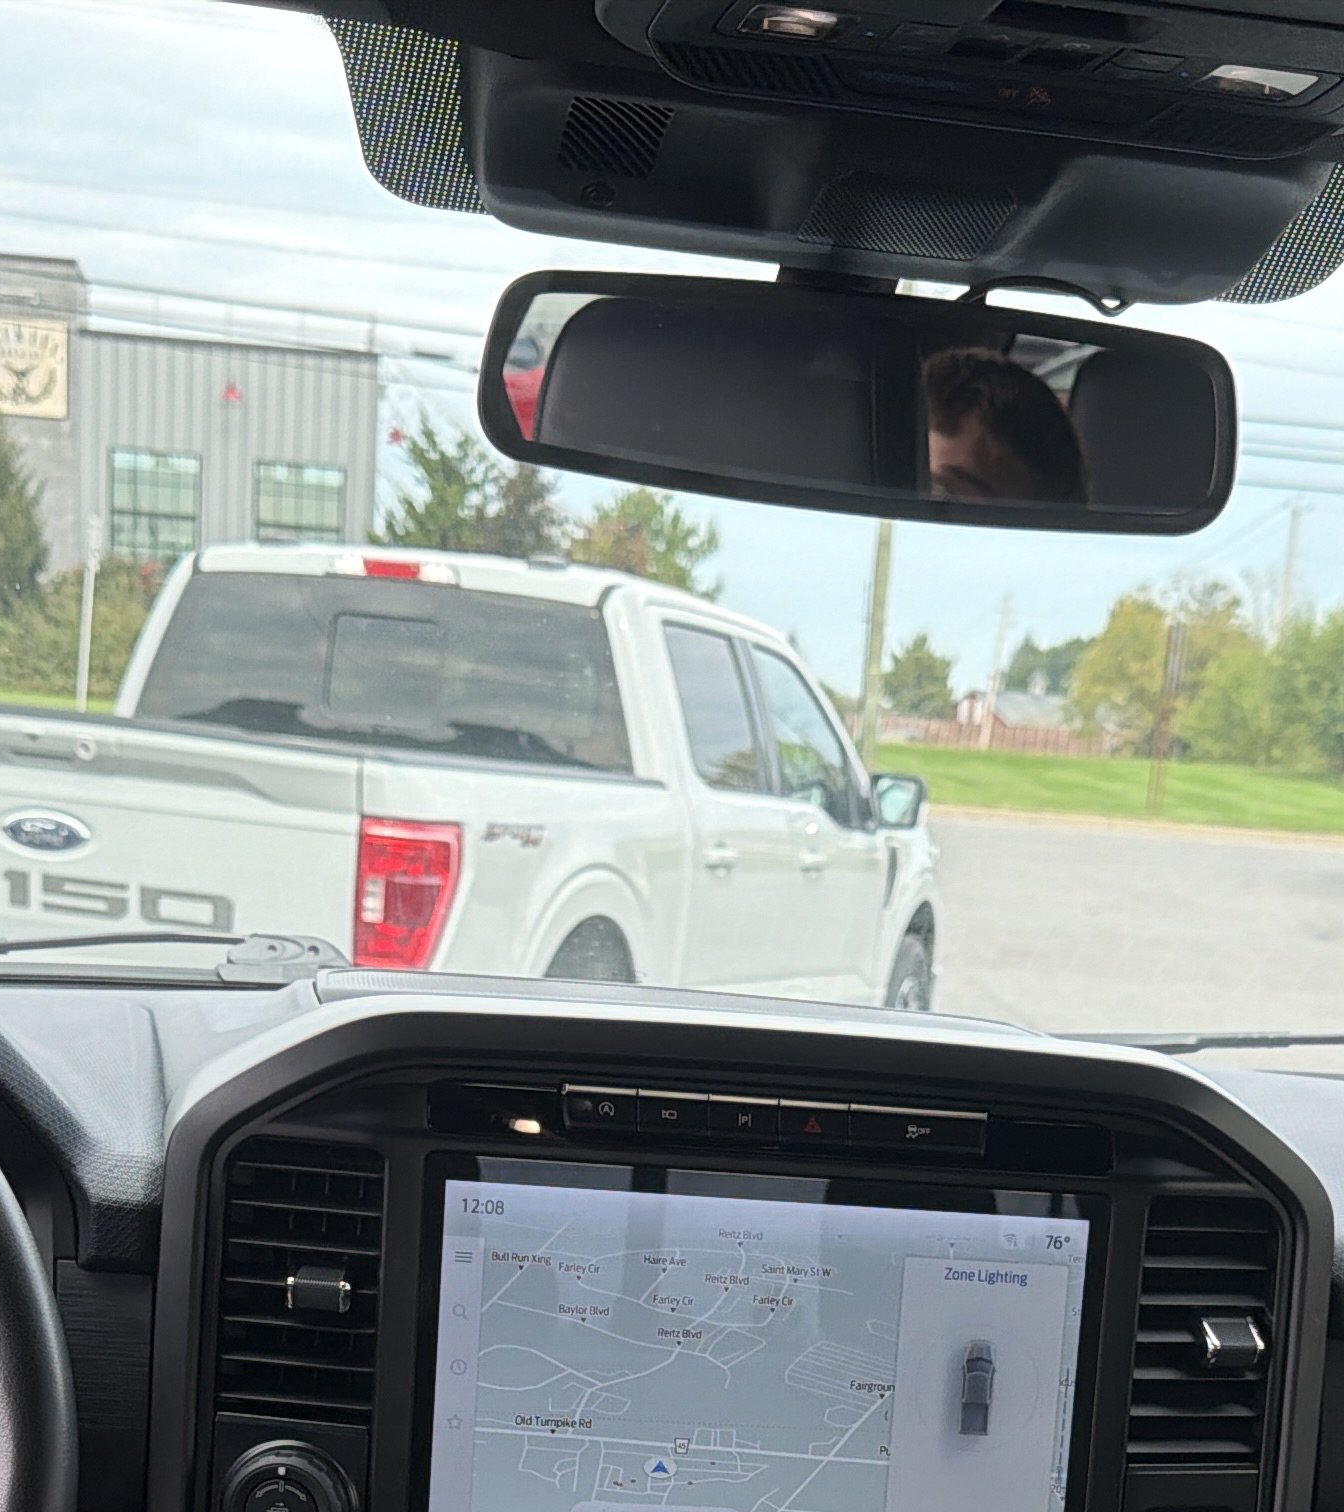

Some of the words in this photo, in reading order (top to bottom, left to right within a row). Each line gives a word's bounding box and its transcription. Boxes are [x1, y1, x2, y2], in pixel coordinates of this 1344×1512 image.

[462, 1198, 505, 1215] 12:08
[718, 1229, 741, 1240] Reitz
[742, 1230, 763, 1241] Blvd
[1045, 1234, 1071, 1250] 76°
[491, 1251, 509, 1263] Bull
[511, 1252, 530, 1263] Run
[531, 1254, 552, 1266] Xing
[668, 1257, 687, 1267] Ave
[558, 1262, 585, 1275] Farley
[586, 1264, 600, 1274] Cir
[761, 1264, 785, 1275] Saint
[786, 1265, 809, 1279] Mary
[821, 1268, 832, 1277] W
[704, 1274, 728, 1285] Reitz
[729, 1275, 750, 1286] Blvd
[943, 1267, 976, 1282] Zone
[977, 1269, 1028, 1287] Lighting
[652, 1295, 678, 1306] Farley
[679, 1296, 694, 1306] Cir
[753, 1296, 778, 1308] Farley
[779, 1297, 794, 1307] Cir
[558, 1304, 588, 1316] Baylor
[589, 1306, 610, 1316] Blvd
[657, 1328, 680, 1339] Reitz
[681, 1329, 703, 1340] Blvd
[514, 1415, 533, 1426] Old
[534, 1416, 578, 1430] Turnpike
[578, 1418, 593, 1429] Rd
